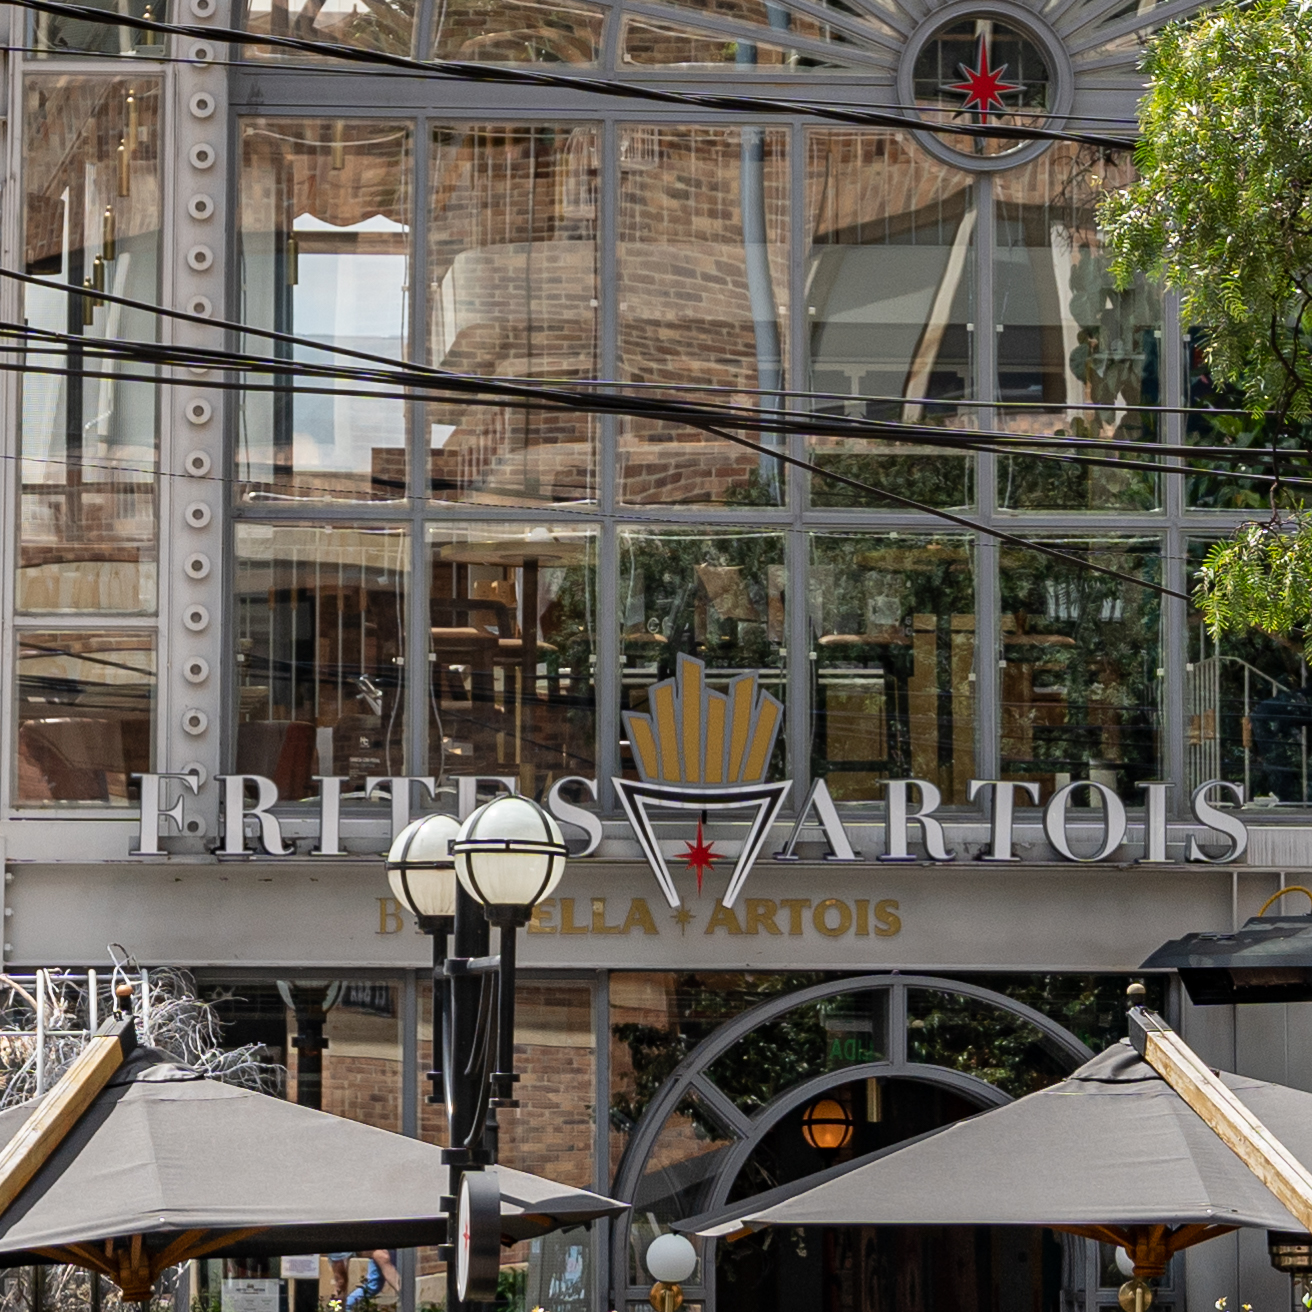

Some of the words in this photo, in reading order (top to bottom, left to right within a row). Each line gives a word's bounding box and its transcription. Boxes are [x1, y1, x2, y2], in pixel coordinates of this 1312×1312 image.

[773, 778, 1250, 864] ARTOIS
[527, 897, 657, 935] ELLA
[705, 897, 902, 937] ARTOIS
